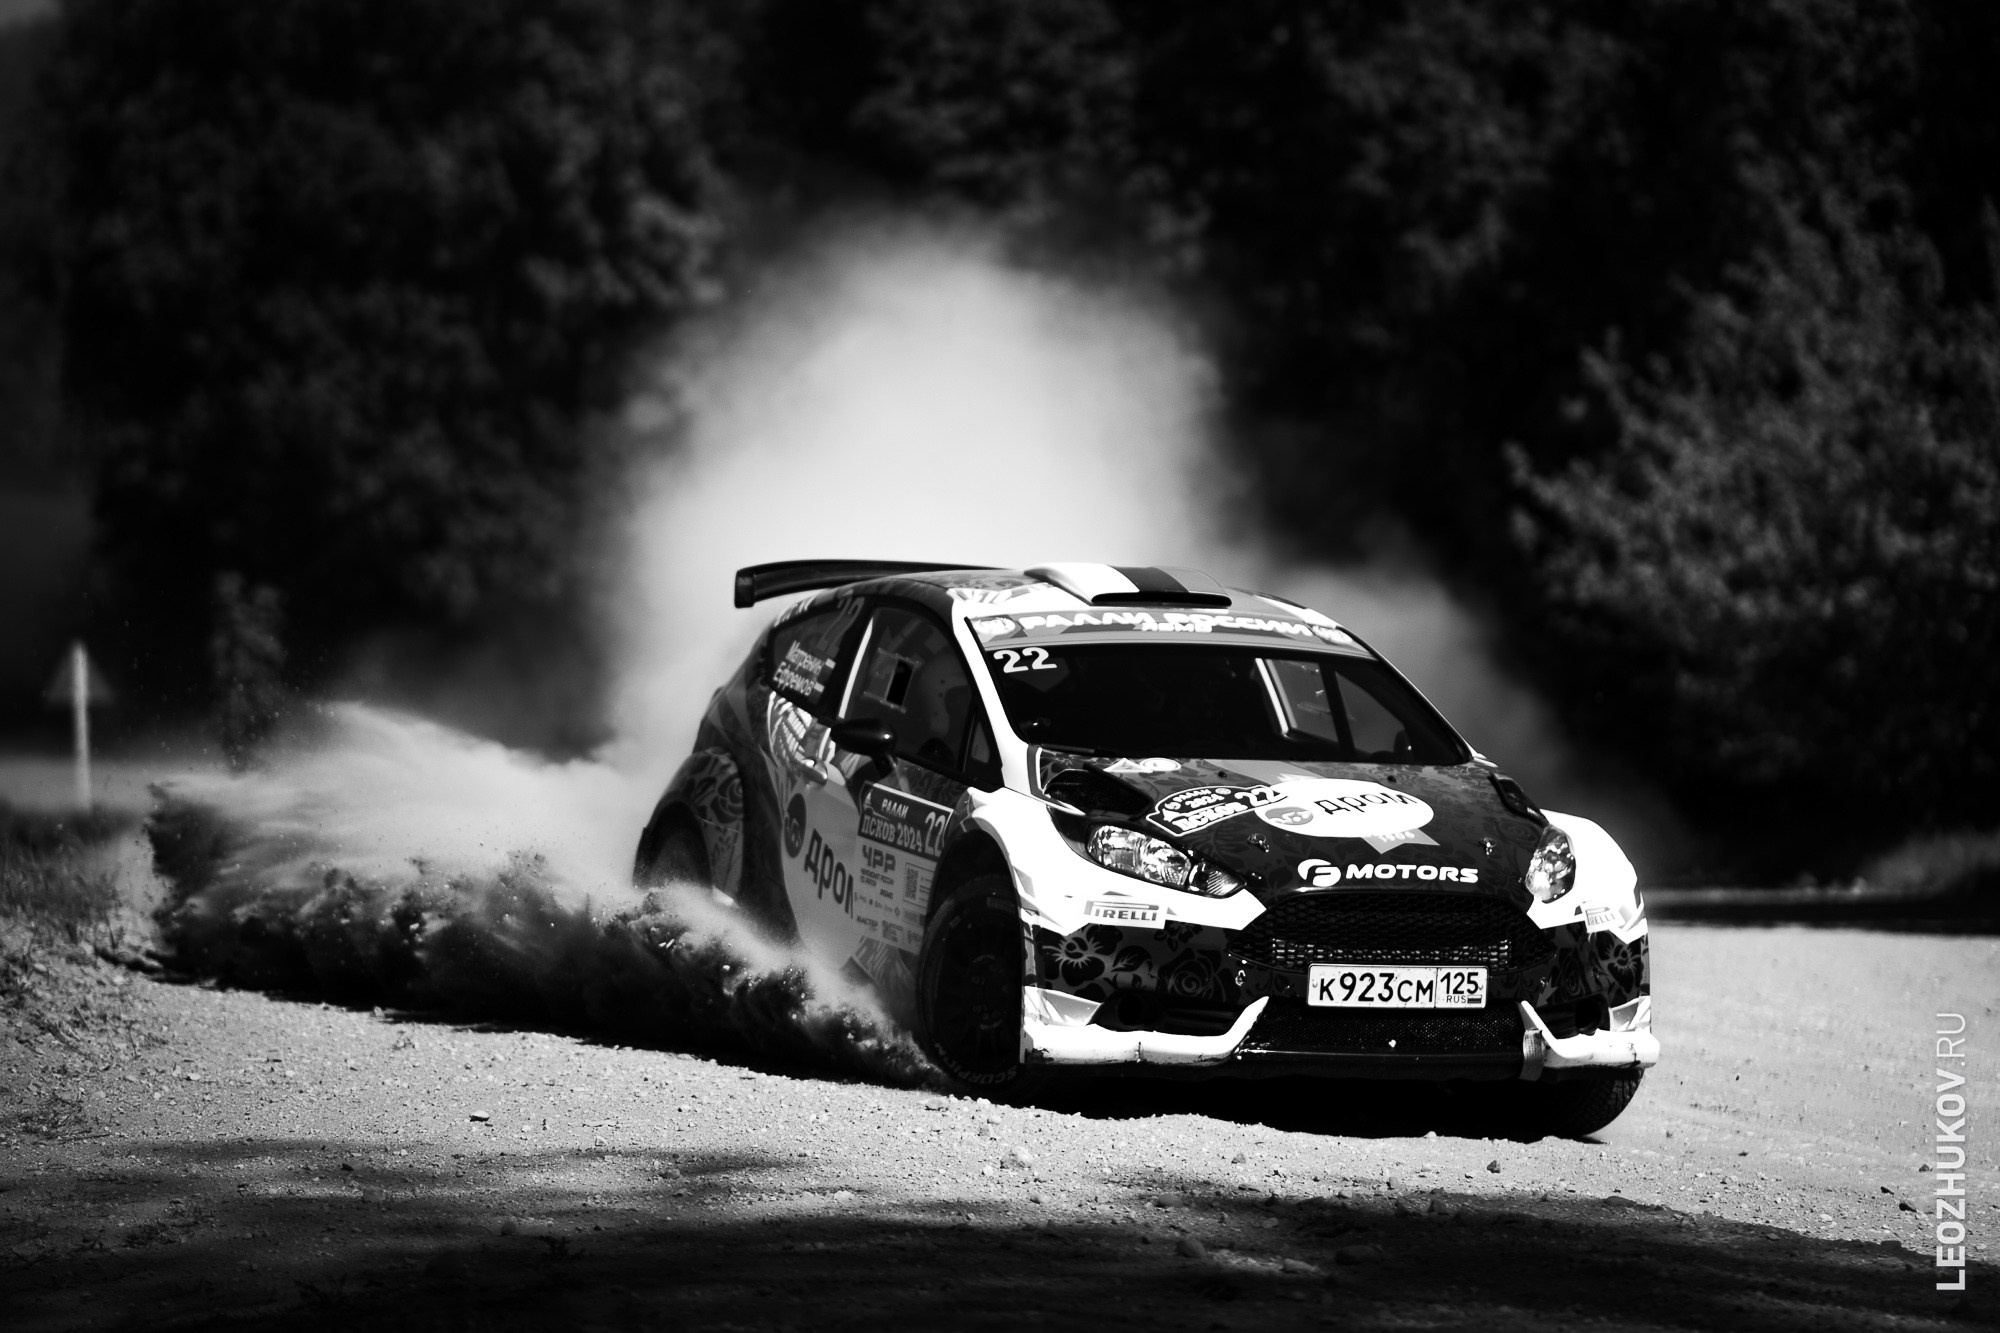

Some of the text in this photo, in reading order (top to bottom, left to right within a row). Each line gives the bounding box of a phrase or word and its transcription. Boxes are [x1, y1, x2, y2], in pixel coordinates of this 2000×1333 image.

[993, 646, 1058, 674] 22
[881, 798, 909, 820] РАЛЛИ
[860, 814, 923, 853] ПСКОВ 2024
[1345, 863, 1479, 884] MOTORS
[1439, 972, 1480, 994] 125
[1446, 995, 1467, 1004] RUS
